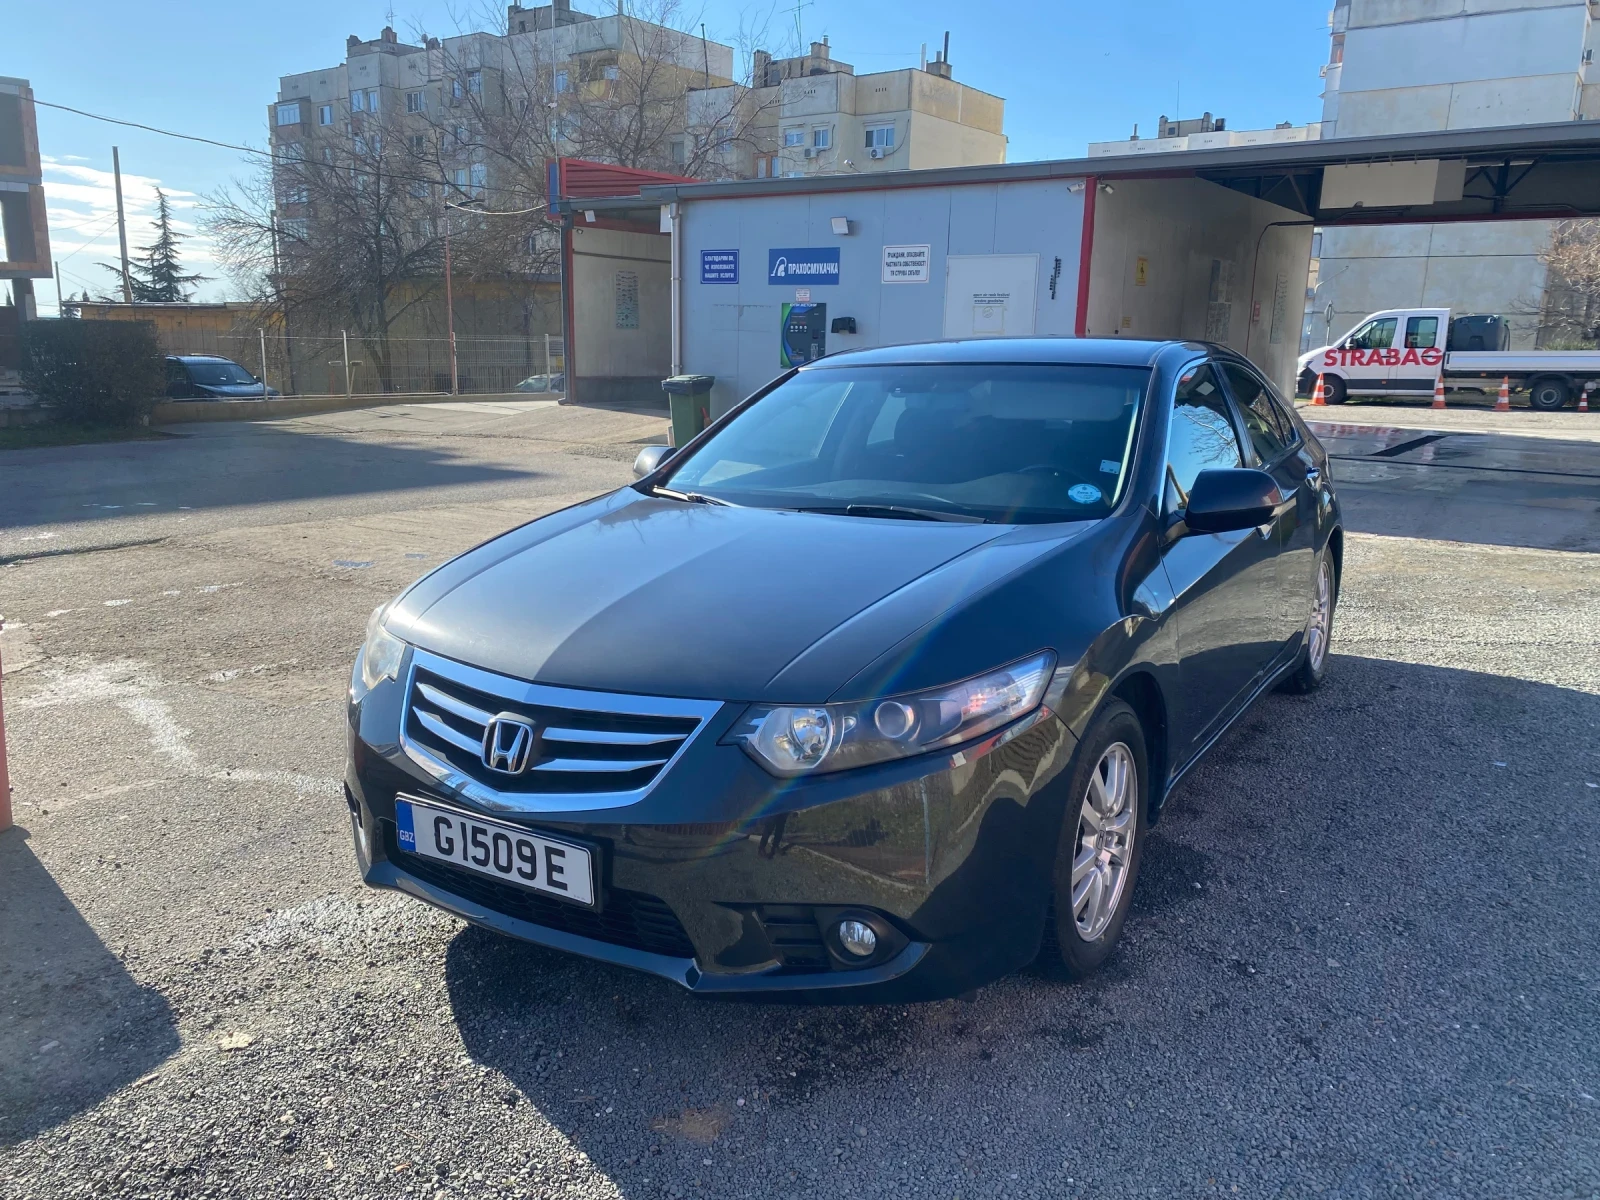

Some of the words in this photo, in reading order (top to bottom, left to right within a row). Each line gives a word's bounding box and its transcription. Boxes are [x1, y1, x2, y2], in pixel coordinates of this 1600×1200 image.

[788, 262, 839, 275] ПРАХОСМУКАЧКА
[1324, 347, 1443, 366] STRABAG
[399, 829, 415, 843] GBZ
